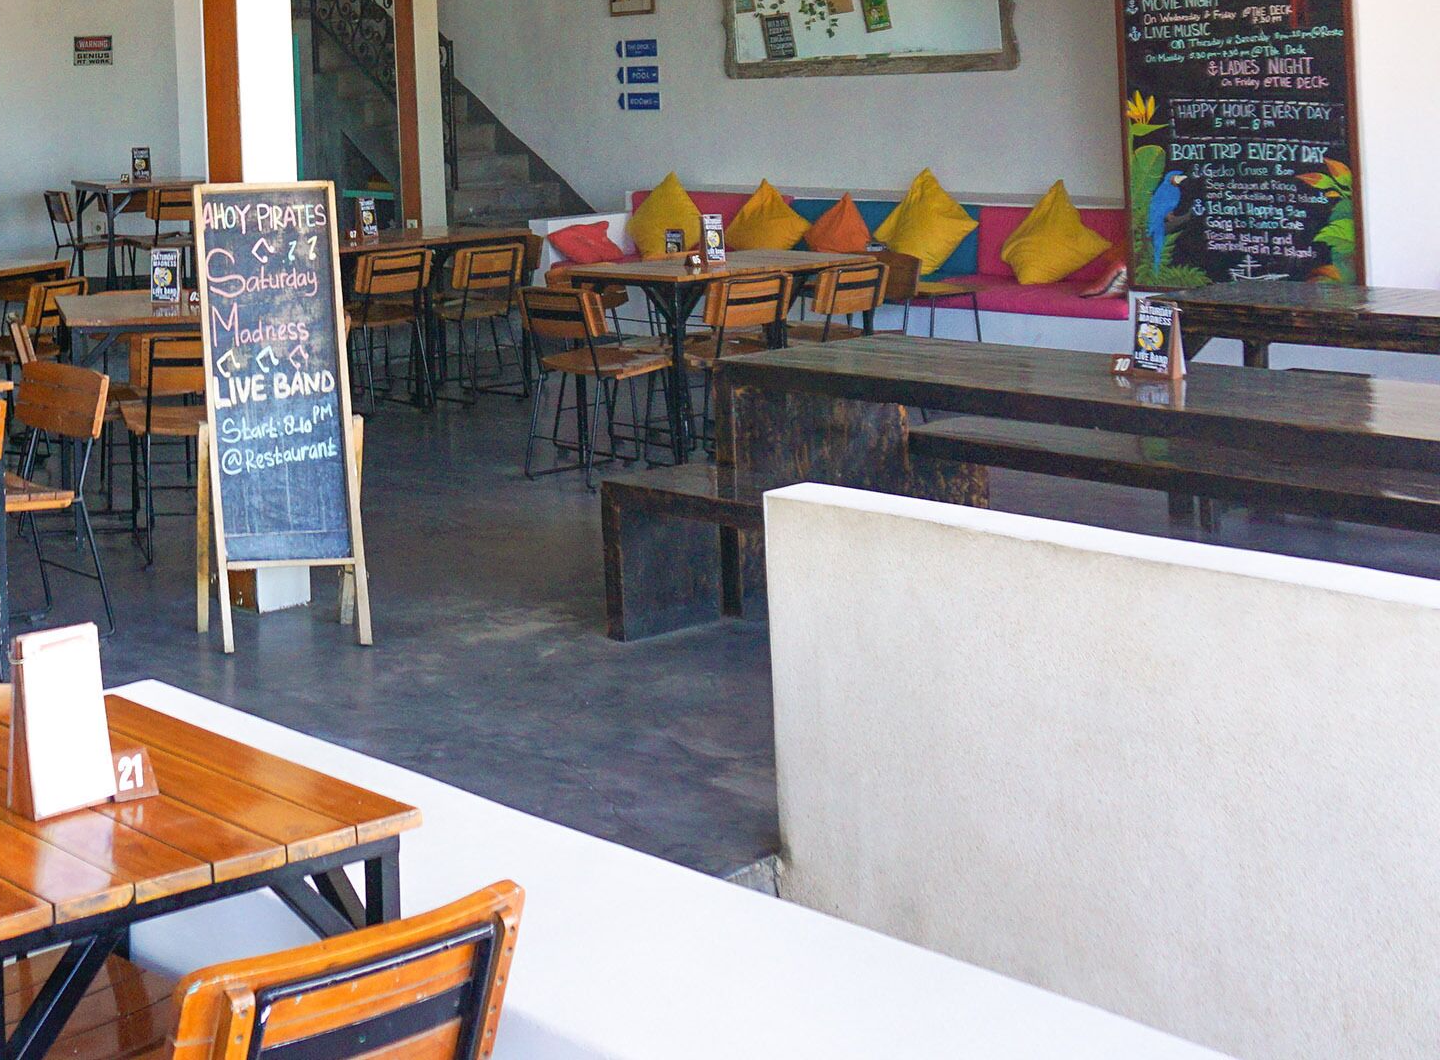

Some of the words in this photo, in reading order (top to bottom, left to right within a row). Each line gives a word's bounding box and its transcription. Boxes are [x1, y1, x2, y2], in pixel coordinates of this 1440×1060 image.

[1144, 14, 1157, 25] On
[1213, 10, 1237, 21] Friday
[1270, 5, 1293, 16] DECK
[1144, 25, 1171, 39] LIVE
[1174, 22, 1211, 38] MUSIC
[79, 39, 108, 48] WARNING
[1220, 57, 1261, 76] LADIES
[1268, 56, 1314, 74] NIGHT
[1234, 77, 1260, 89] Friday
[1297, 76, 1329, 89] DECK
[1178, 104, 1218, 119] HAPPY
[1222, 104, 1257, 118] HOUR
[1262, 104, 1302, 120] EVERY
[1306, 106, 1333, 121] DAY
[1215, 118, 1222, 128] 5
[1170, 144, 1206, 160] BOAT
[1210, 144, 1242, 159] TRIP
[1247, 144, 1299, 161] EVERY
[1302, 146, 1328, 163] DAY
[1206, 179, 1224, 190] See
[1289, 194, 1297, 203] 2
[1208, 201, 1244, 216] Island
[203, 202, 251, 234] AHOY
[256, 203, 327, 231] PIRATES
[1206, 216, 1233, 231] Going
[1273, 246, 1282, 255] 2
[206, 248, 318, 298] Saturday
[211, 302, 309, 348] Madness
[1114, 358, 1130, 371] 10
[213, 373, 267, 410] LIVE
[273, 370, 335, 399] BAND
[313, 403, 333, 424] PM
[221, 436, 338, 476] @Restaurant
[117, 753, 144, 791] 21
